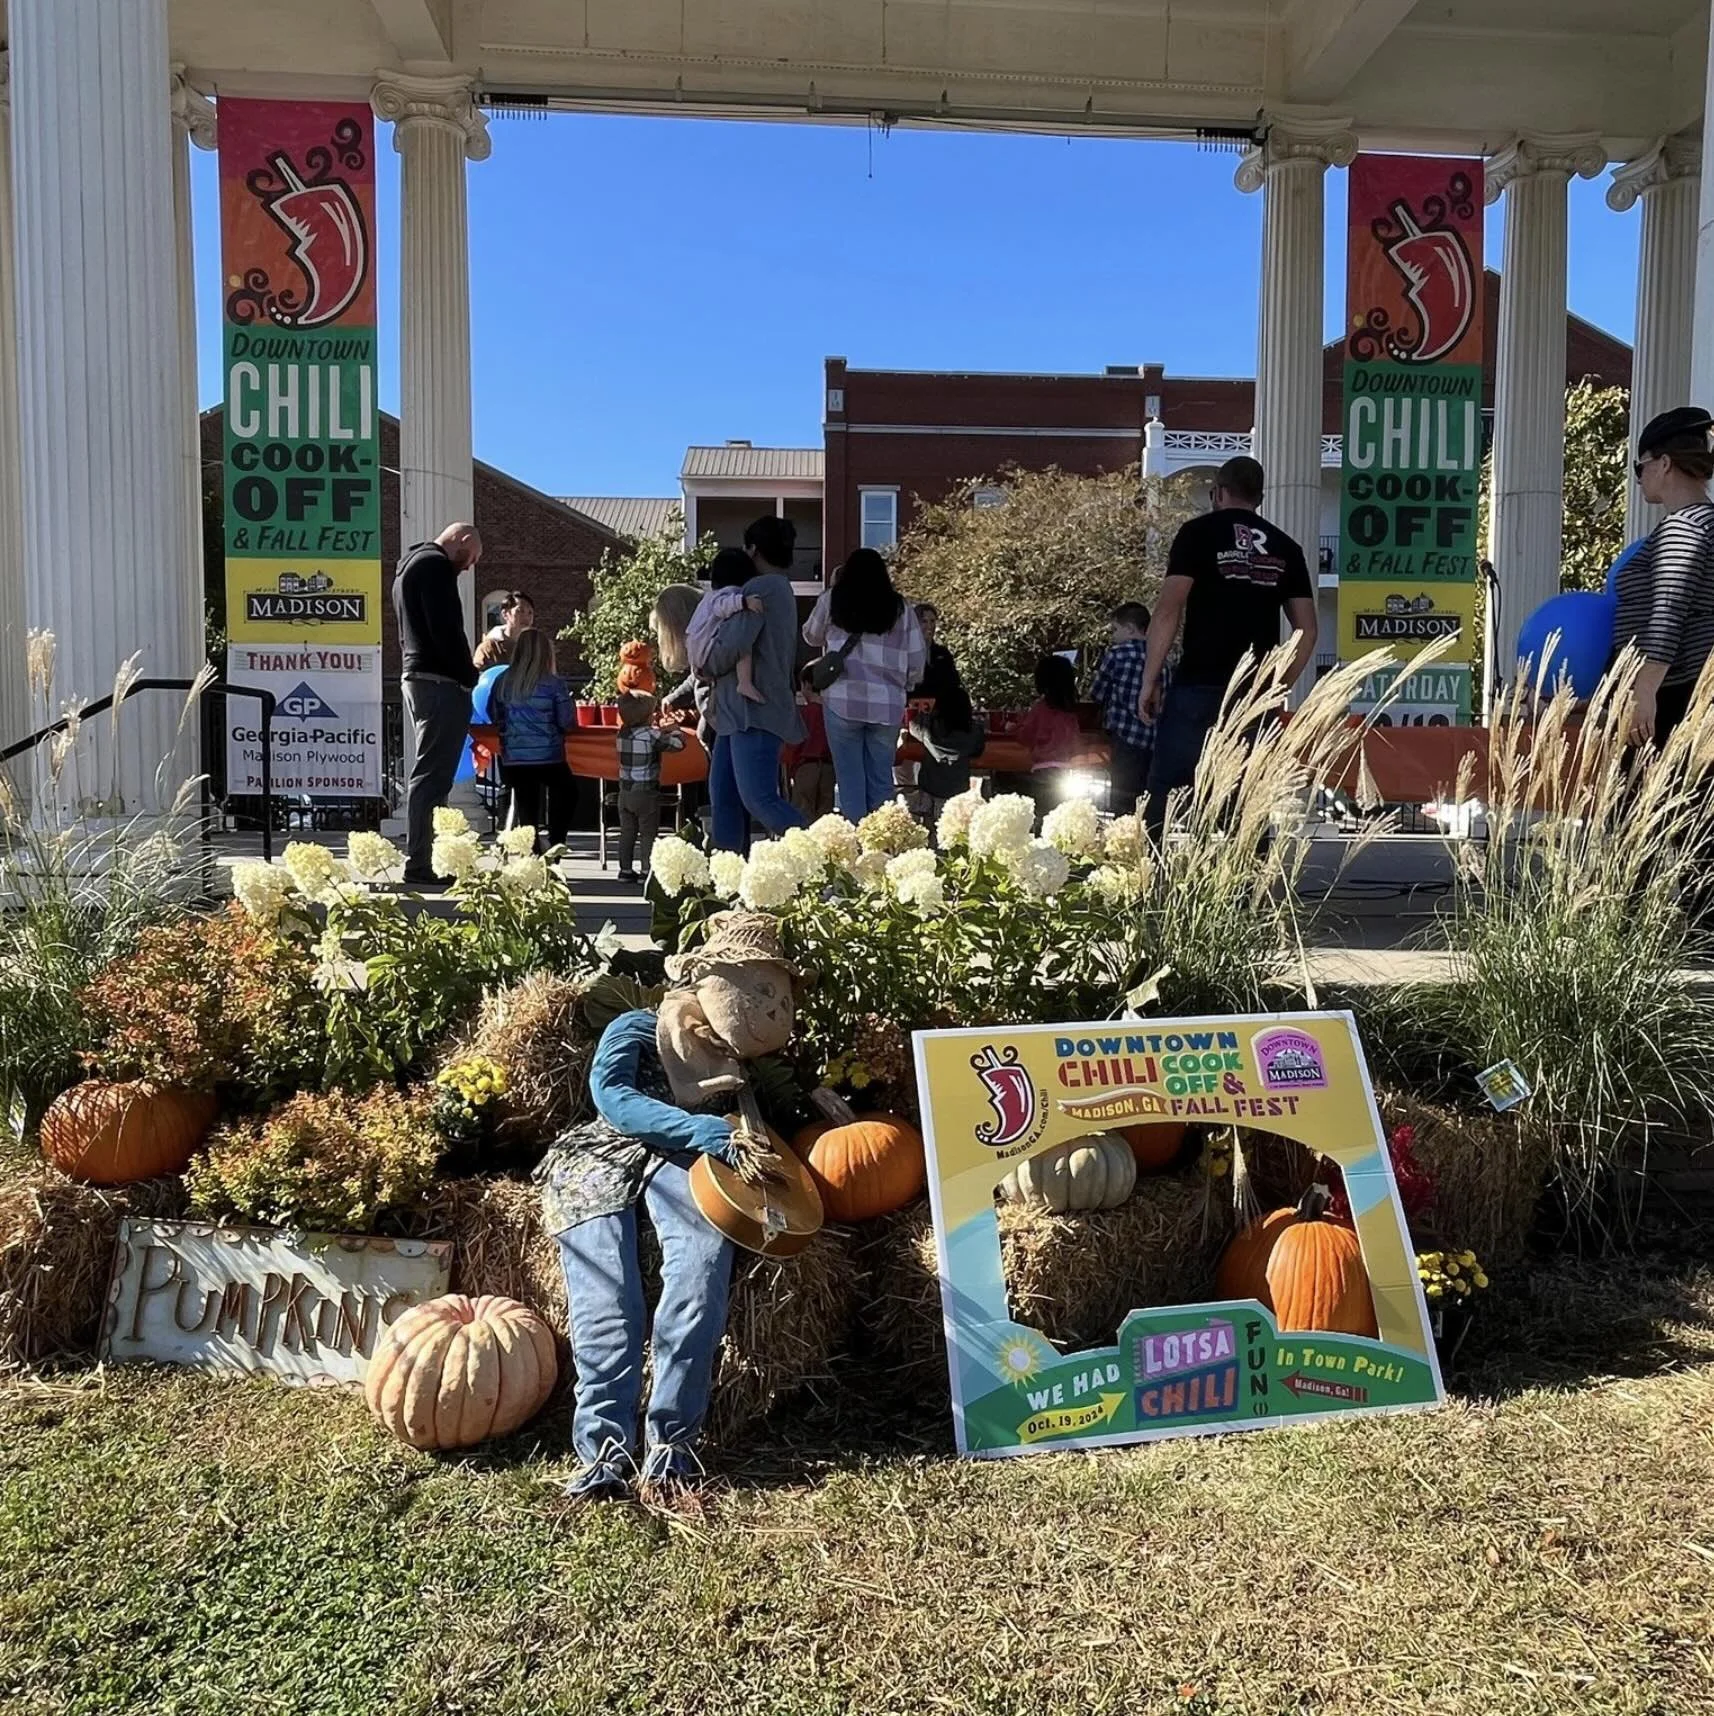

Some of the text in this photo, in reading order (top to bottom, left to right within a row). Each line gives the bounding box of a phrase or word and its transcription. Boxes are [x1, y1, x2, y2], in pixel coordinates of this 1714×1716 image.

[231, 332, 370, 360] DOWNTOWN
[1352, 369, 1474, 396] DOWNTOWN
[230, 361, 371, 440] CHILI
[1348, 396, 1475, 470] CHILI
[231, 442, 372, 473] COOK-
[232, 476, 371, 522] OFF
[1347, 473, 1473, 501] COOK-
[233, 526, 374, 551] & FALL FEST
[1348, 504, 1472, 547] OFF
[1346, 551, 1473, 576] & FALL FEST
[250, 597, 361, 618] MADISON
[1359, 618, 1457, 637] MADISON
[247, 651, 362, 671] THANK YOU!
[1356, 674, 1462, 701] ATRDAY
[283, 697, 321, 716] GP
[242, 749, 365, 764] Maison Plywood
[246, 775, 364, 788] PAILION SPONSOR
[1055, 1031, 1238, 1058] DOWNTOWN
[1260, 1038, 1318, 1057] DOWNTOWN
[1058, 1051, 1244, 1088] CHILI COOK
[1268, 1067, 1322, 1083] MADISON
[1164, 1071, 1246, 1096] OFF &
[1142, 1096, 1161, 1113] GA
[1170, 1095, 1300, 1118] FALL FEST
[1145, 1330, 1231, 1374] LOTSA
[1276, 1347, 1405, 1383] In Town Park!
[1026, 1363, 1121, 1411] WE HAD
[1141, 1367, 1236, 1416] CHILI
